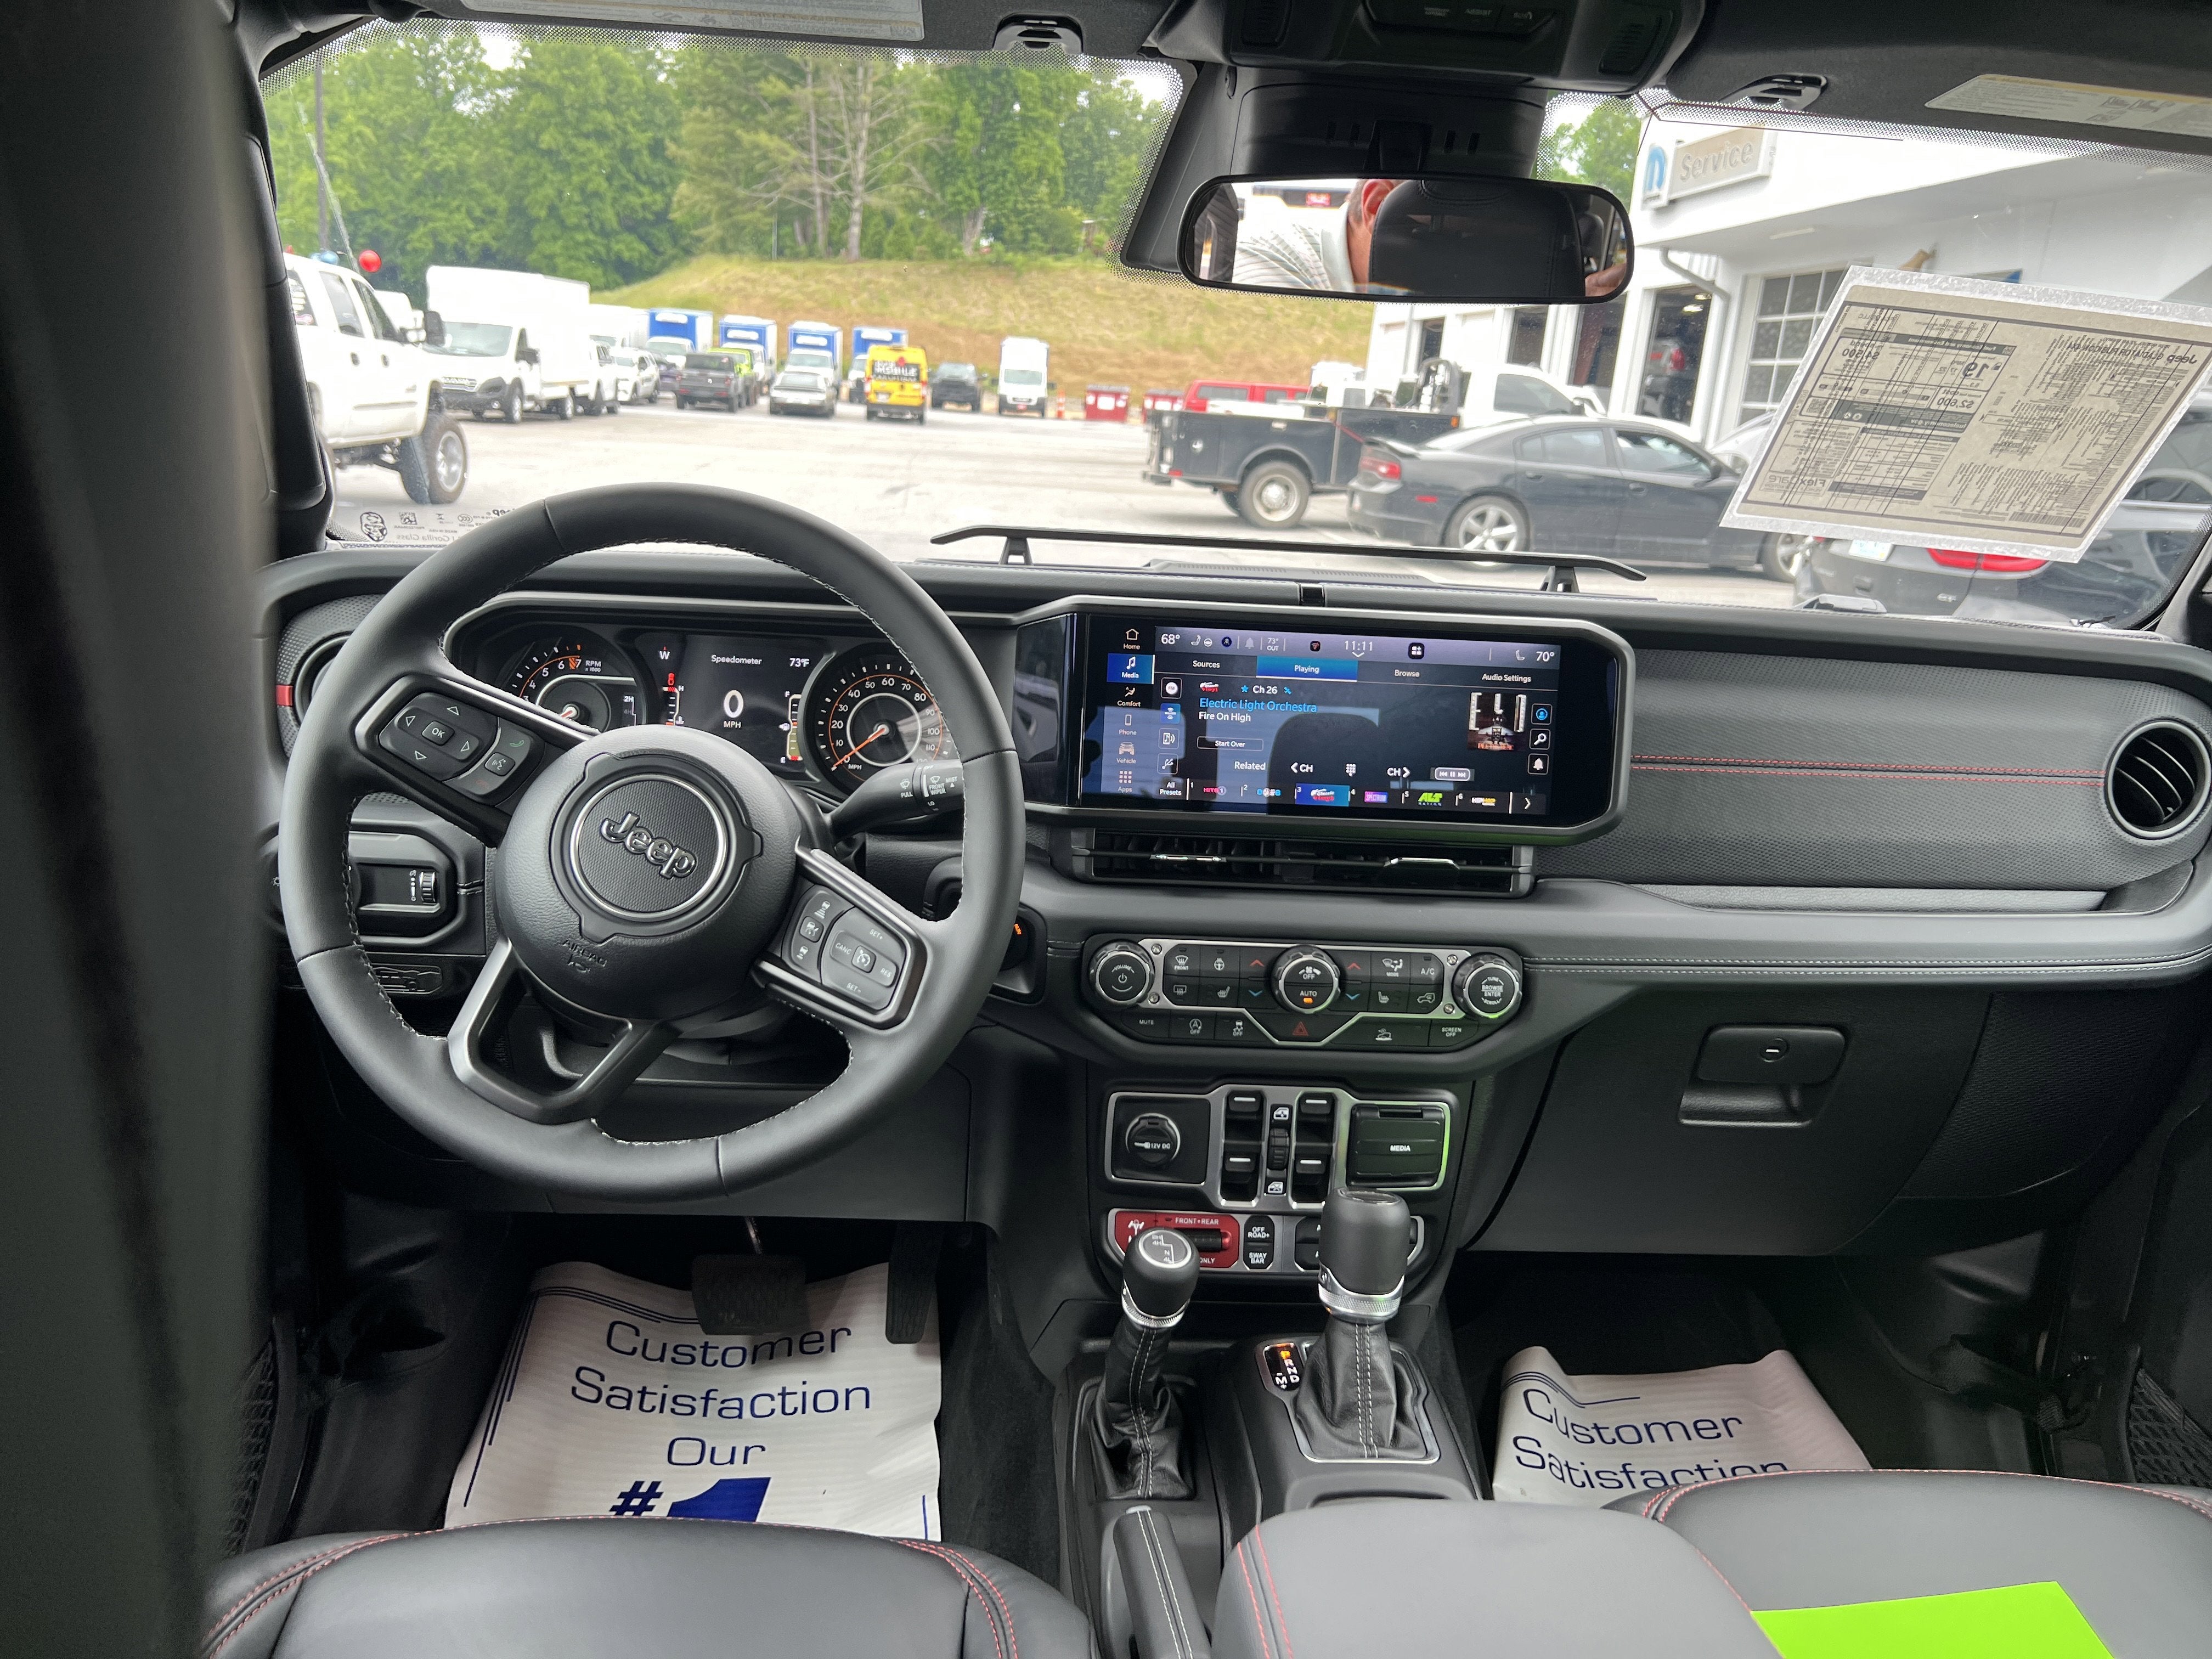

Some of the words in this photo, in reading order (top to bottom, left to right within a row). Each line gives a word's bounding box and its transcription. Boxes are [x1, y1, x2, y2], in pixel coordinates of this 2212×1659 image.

[1680, 142, 1753, 183] Service
[1160, 634, 1181, 645] 68°
[1345, 640, 1373, 651] 11:11
[659, 651, 670, 660] W
[711, 654, 763, 665] Speedometer
[1536, 651, 1555, 662] 70°
[557, 661, 565, 670] 6
[1192, 660, 1221, 668] Sources
[1294, 664, 1320, 674] Playing
[541, 667, 549, 678] 5
[1394, 669, 1420, 678] Browse
[881, 678, 895, 686] 60
[1482, 673, 1503, 681] Audio
[1503, 674, 1532, 684] Settings
[529, 680, 536, 690] 4
[1252, 685, 1265, 693] Ch
[1266, 686, 1278, 695] 26
[848, 690, 861, 698] 40
[914, 693, 927, 702] 80
[723, 689, 744, 719] 0
[1199, 697, 1238, 709] Electric
[1239, 699, 1265, 712] Light
[1267, 701, 1318, 713] Orchestra
[1198, 711, 1215, 720] Fire
[1216, 712, 1229, 721] On
[1231, 713, 1251, 723] High
[723, 720, 742, 729] MPH
[831, 720, 844, 729] 20
[432, 727, 445, 738] OK
[1234, 761, 1266, 771] Related
[1299, 764, 1313, 772] CH
[1387, 768, 1401, 776] CH
[1418, 792, 1443, 802] ALT
[601, 811, 698, 880] Jeep
[836, 943, 852, 955] CANC
[880, 967, 891, 978] RES
[606, 1319, 852, 1369] Customer
[1280, 1350, 1291, 1360] P
[1284, 1358, 1294, 1367] R
[1287, 1367, 1298, 1375] N
[1275, 1375, 1288, 1385] M
[1290, 1374, 1300, 1384] D
[571, 1365, 871, 1420] Satisfaction
[1523, 1388, 1743, 1445] Customer
[667, 1437, 766, 1467] Our
